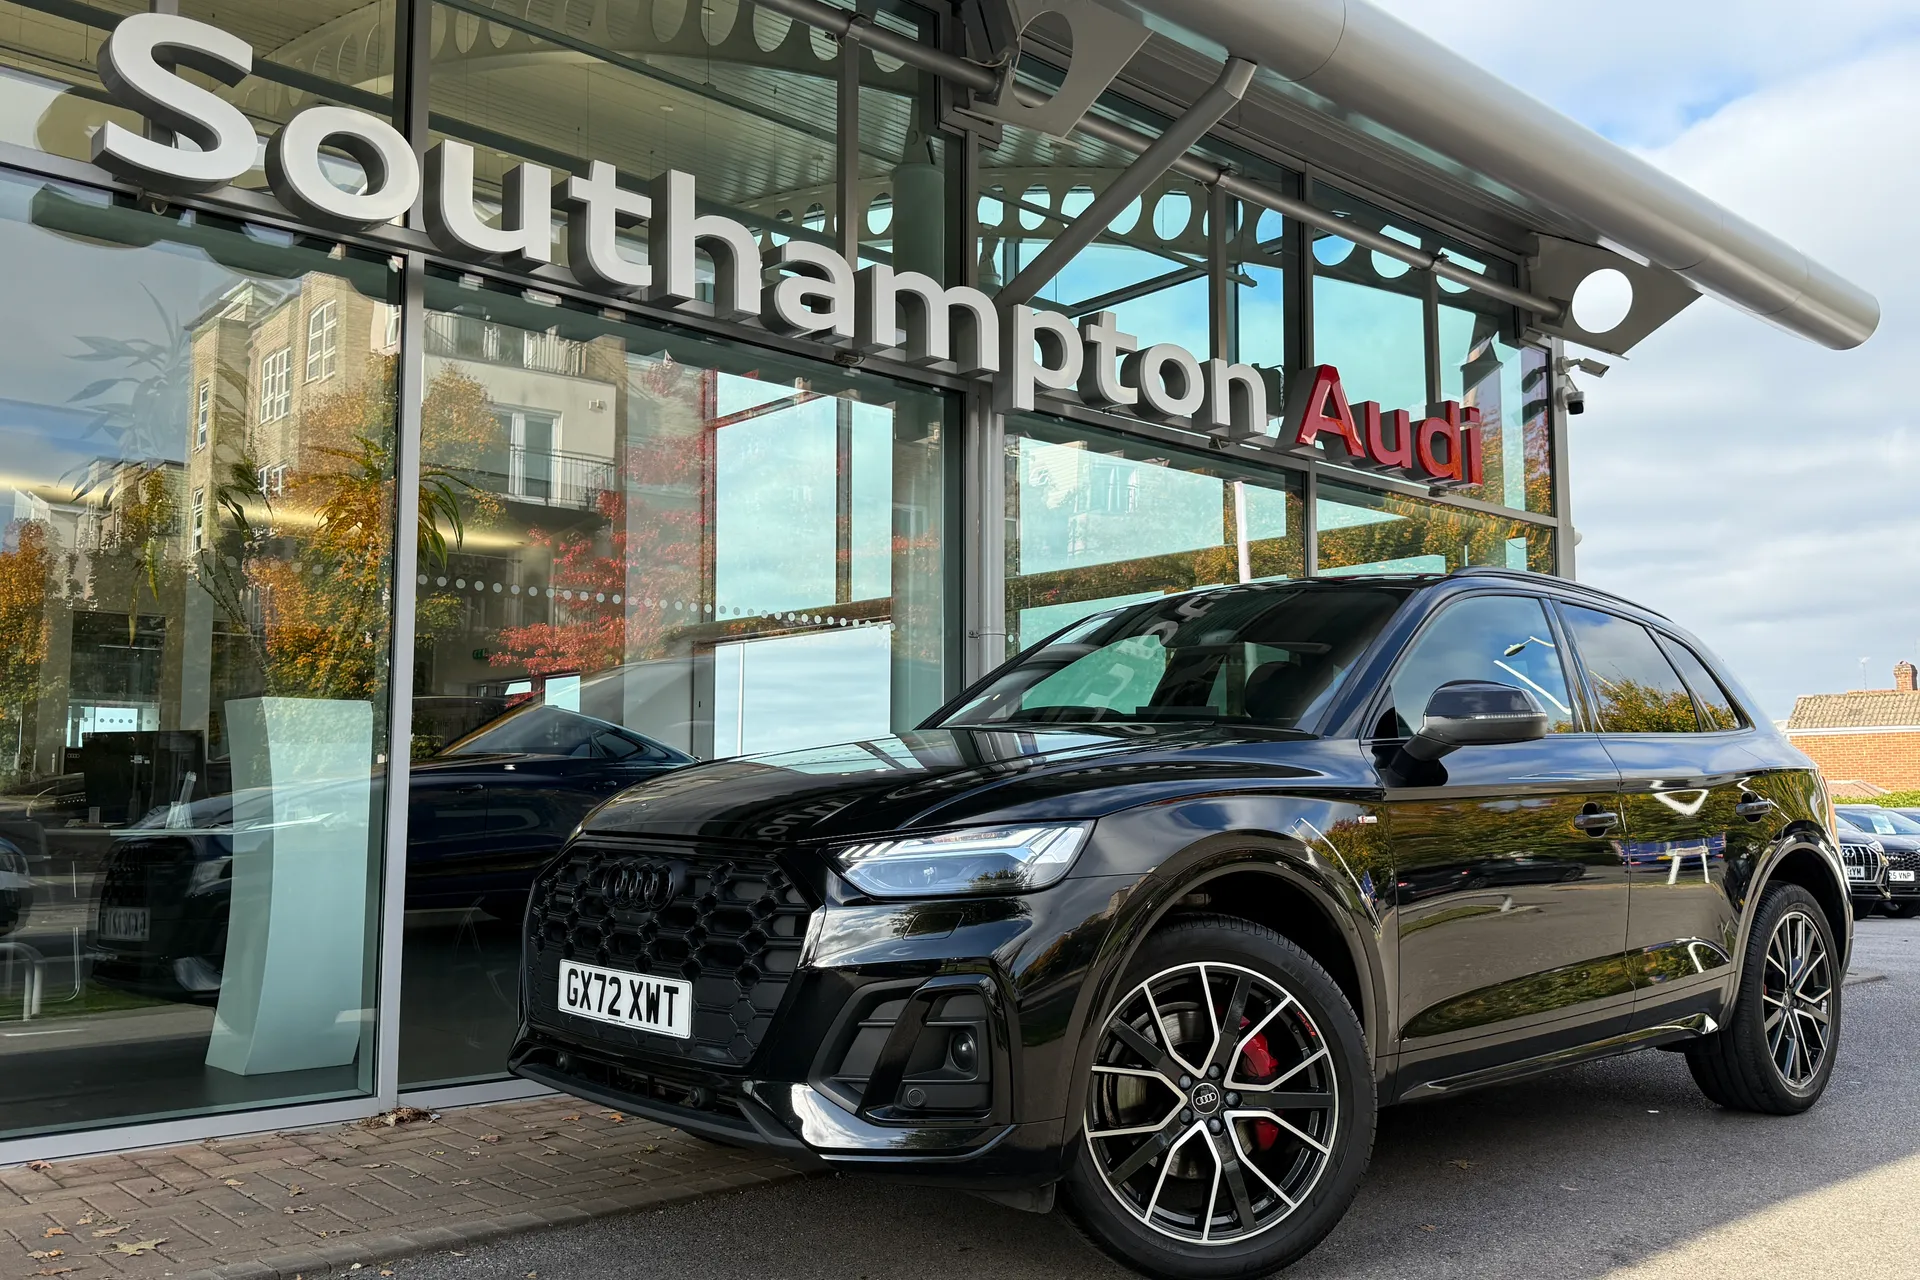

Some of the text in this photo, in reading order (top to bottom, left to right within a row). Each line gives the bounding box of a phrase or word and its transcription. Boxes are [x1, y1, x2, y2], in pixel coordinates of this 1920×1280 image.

[92, 12, 1483, 488] Southampton Audi
[567, 968, 679, 1028] GX72 XWT
